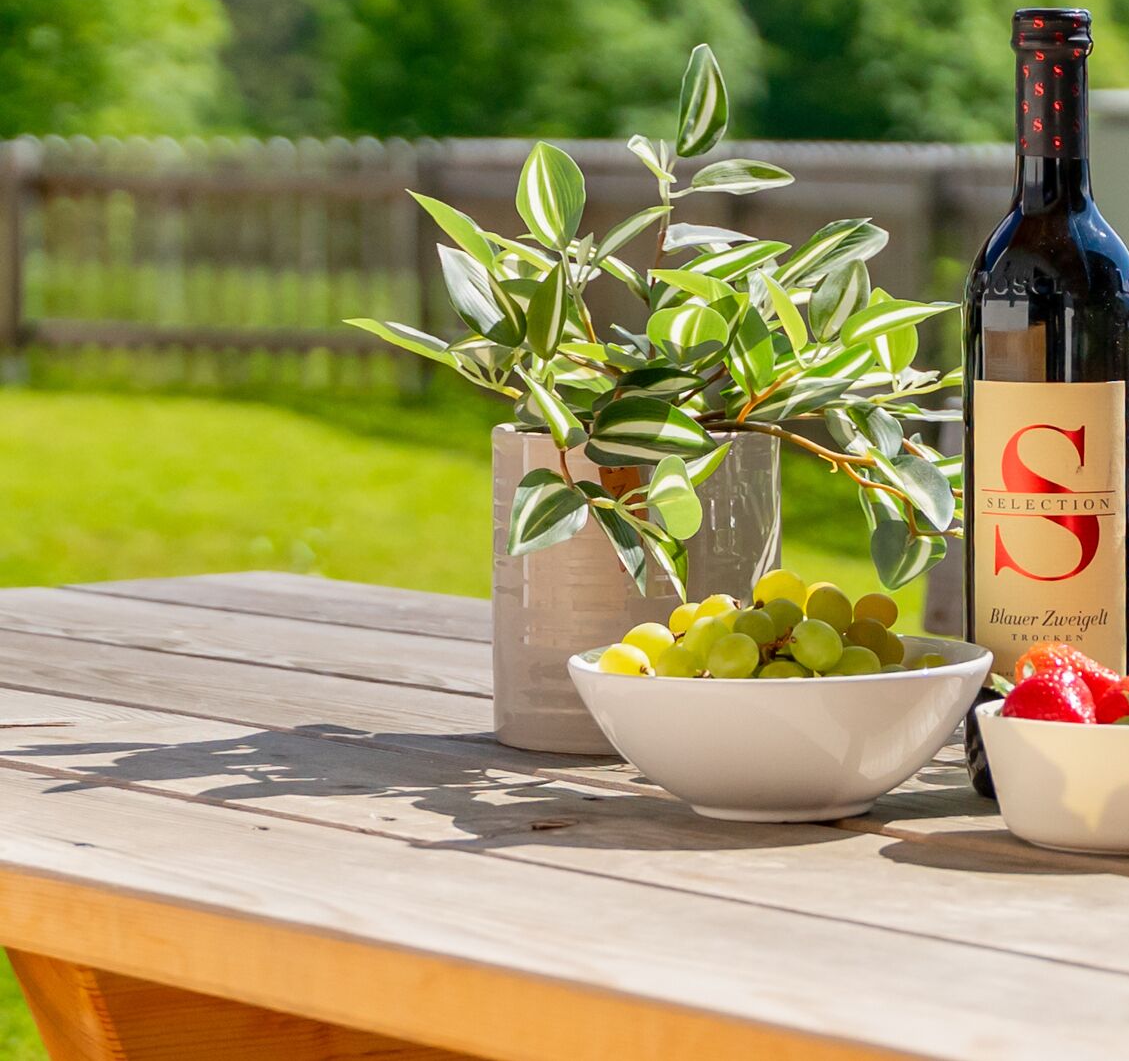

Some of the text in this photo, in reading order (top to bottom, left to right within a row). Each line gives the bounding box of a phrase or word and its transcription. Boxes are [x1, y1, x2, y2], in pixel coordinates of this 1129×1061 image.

[1034, 51, 1045, 61] S
[1034, 82, 1045, 97] S
[1032, 117, 1044, 132] S
[986, 497, 1111, 511] SELECTION
[994, 423, 1100, 581] S
[989, 608, 1109, 632] Blauer Zweigelt
[1011, 633, 1084, 642] TROCKEN
